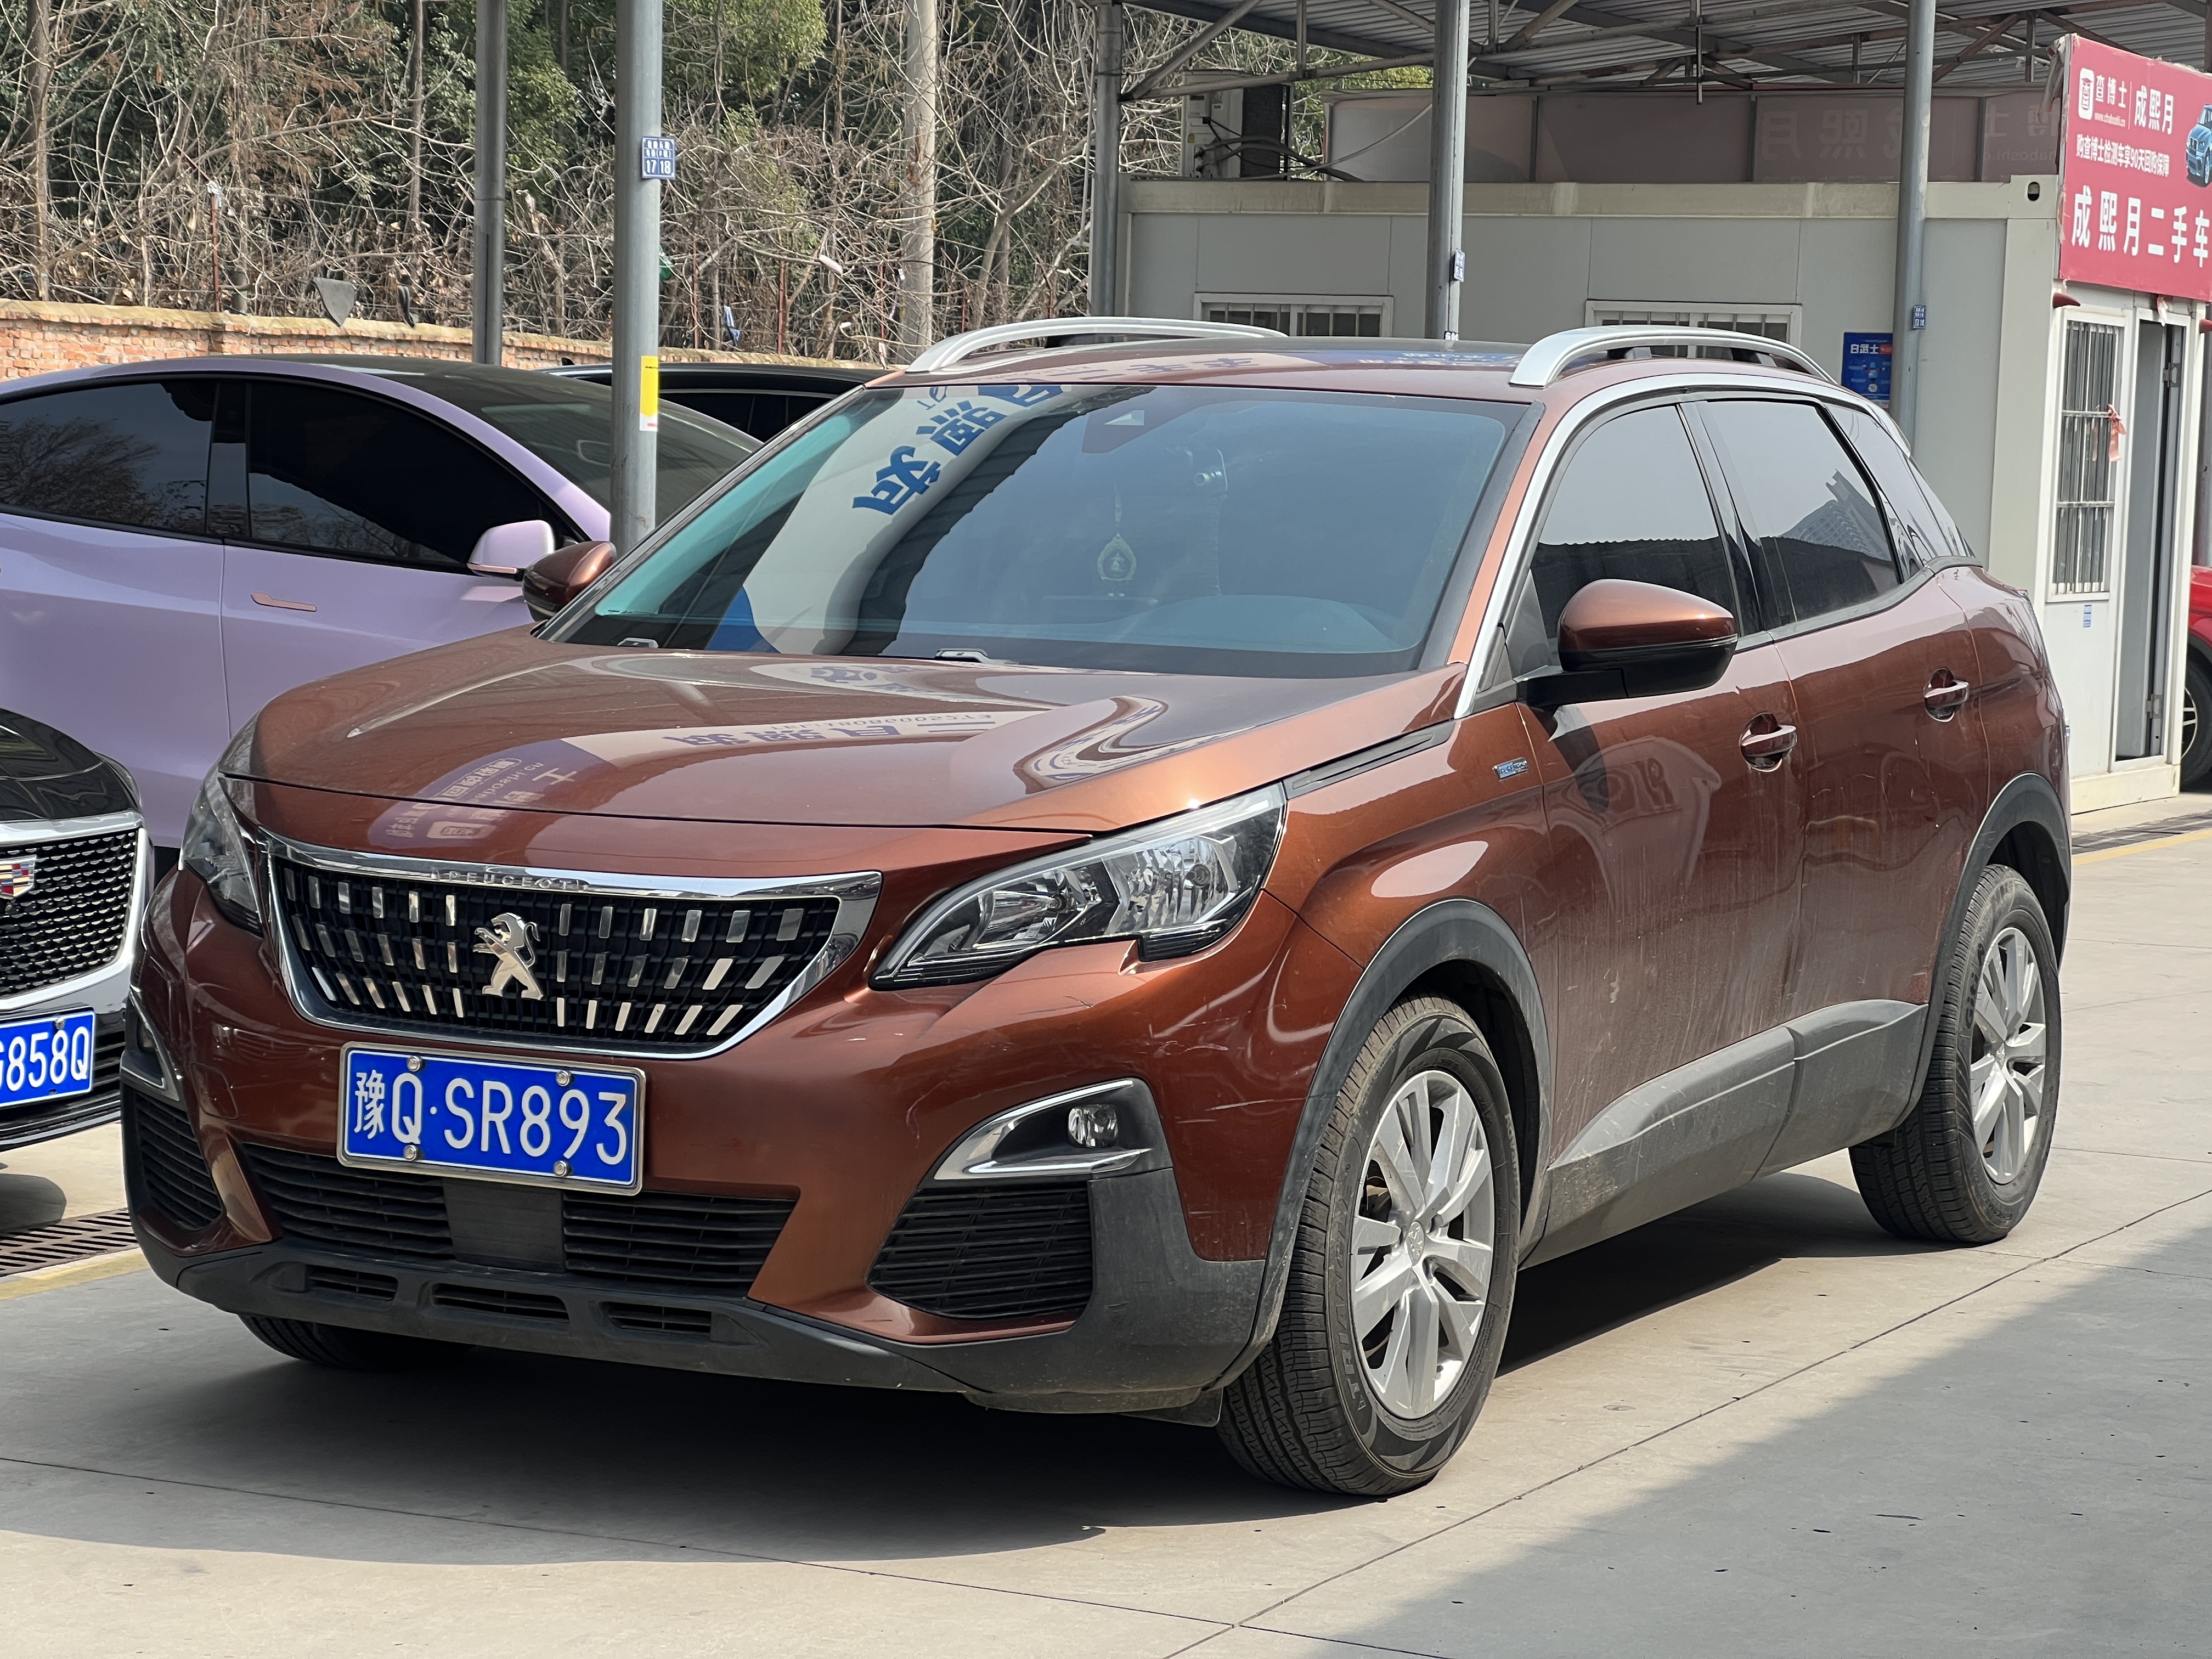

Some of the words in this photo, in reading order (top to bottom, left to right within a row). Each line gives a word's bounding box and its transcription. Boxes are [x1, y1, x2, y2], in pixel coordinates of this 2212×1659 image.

[2095, 74, 2127, 109] 查博士
[2134, 85, 2174, 135] 成熙月
[646, 159, 657, 173] 17
[660, 160, 671, 174] 18
[2072, 185, 2210, 268] 成熙月二手车
[449, 870, 572, 890] PEUGEOT
[1965, 973, 1979, 1029] Giti
[0, 1025, 89, 1092] 858Q
[354, 1069, 628, 1166] 豫Q·SR893
[1333, 1183, 1363, 1400] TRIANGLE
